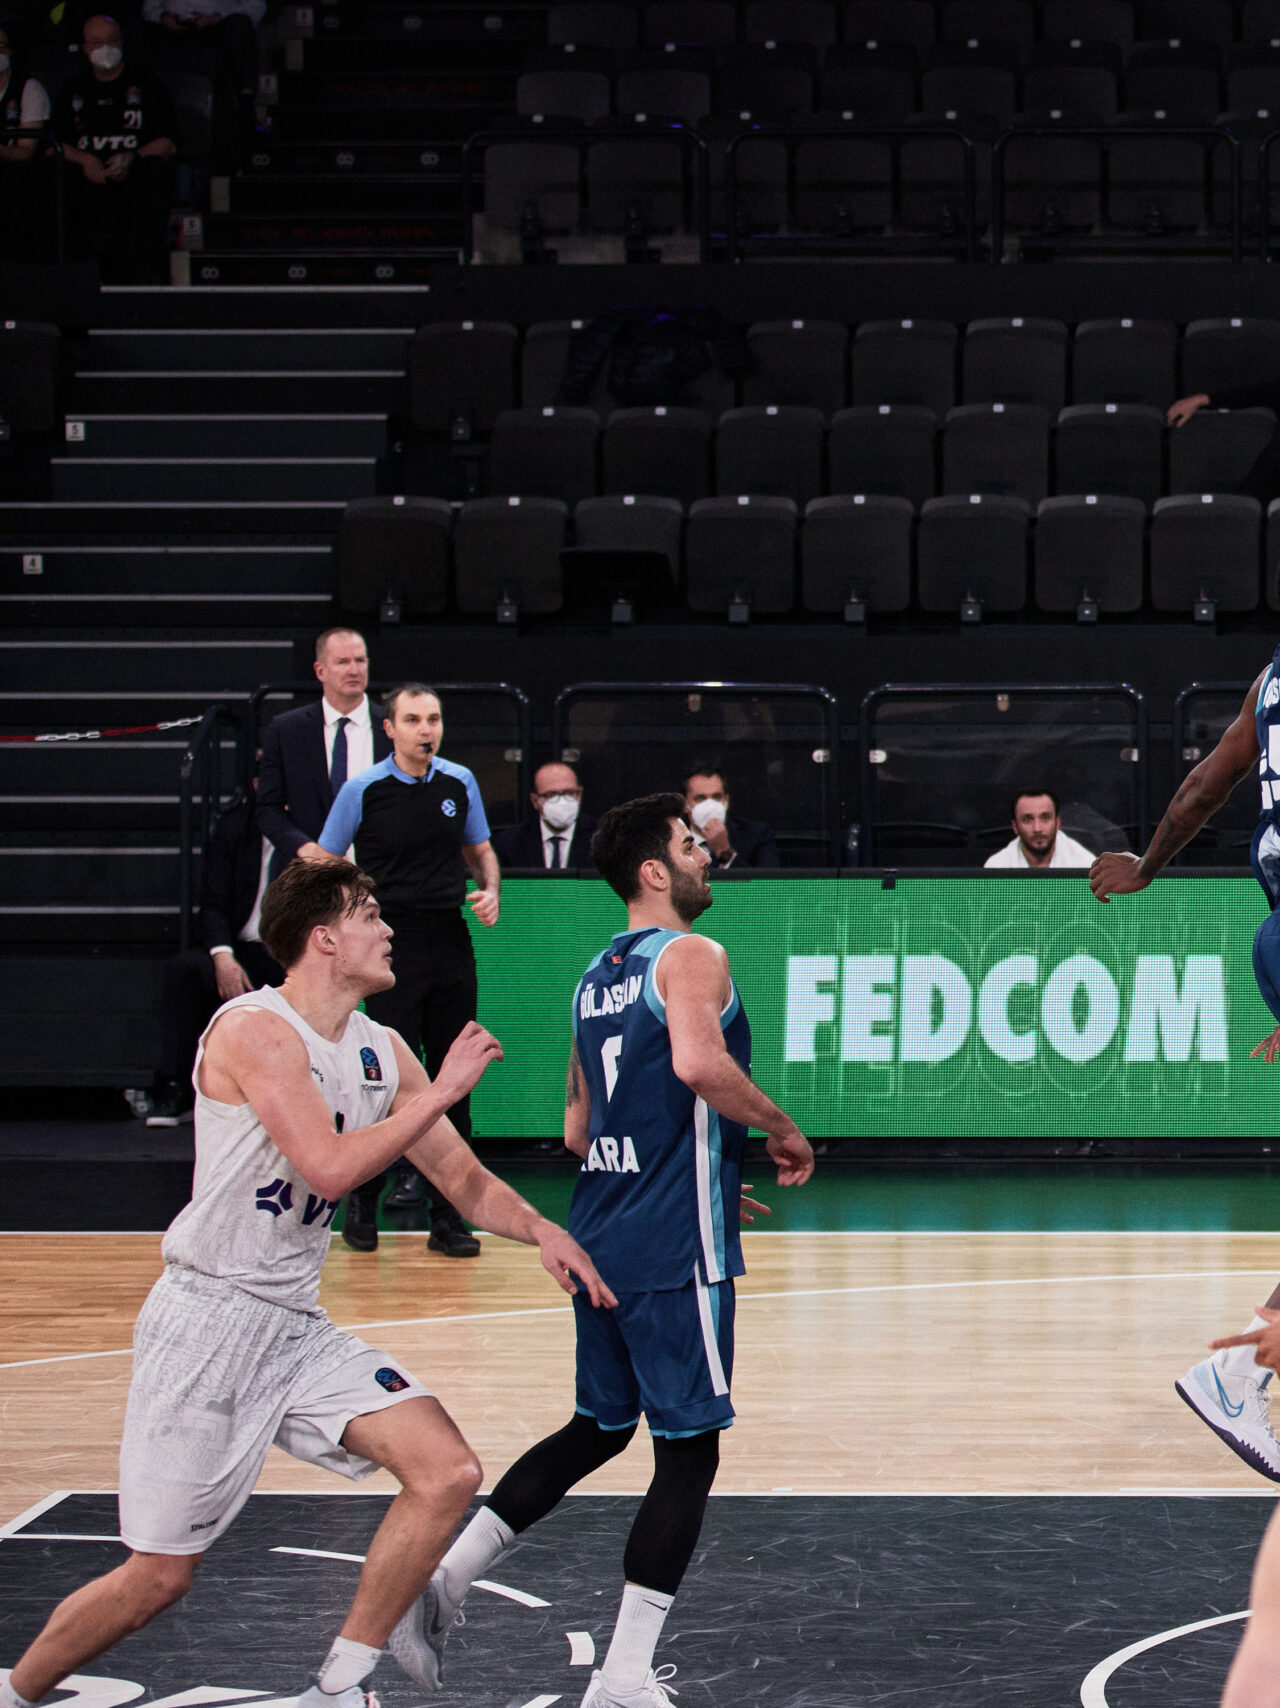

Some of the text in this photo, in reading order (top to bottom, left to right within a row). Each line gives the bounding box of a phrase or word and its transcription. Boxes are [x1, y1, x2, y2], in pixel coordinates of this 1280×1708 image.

[123, 110, 142, 129] 21
[92, 135, 138, 151] VTG
[784, 955, 1229, 1062] FEDCOM
[581, 1136, 641, 1173] ARA
